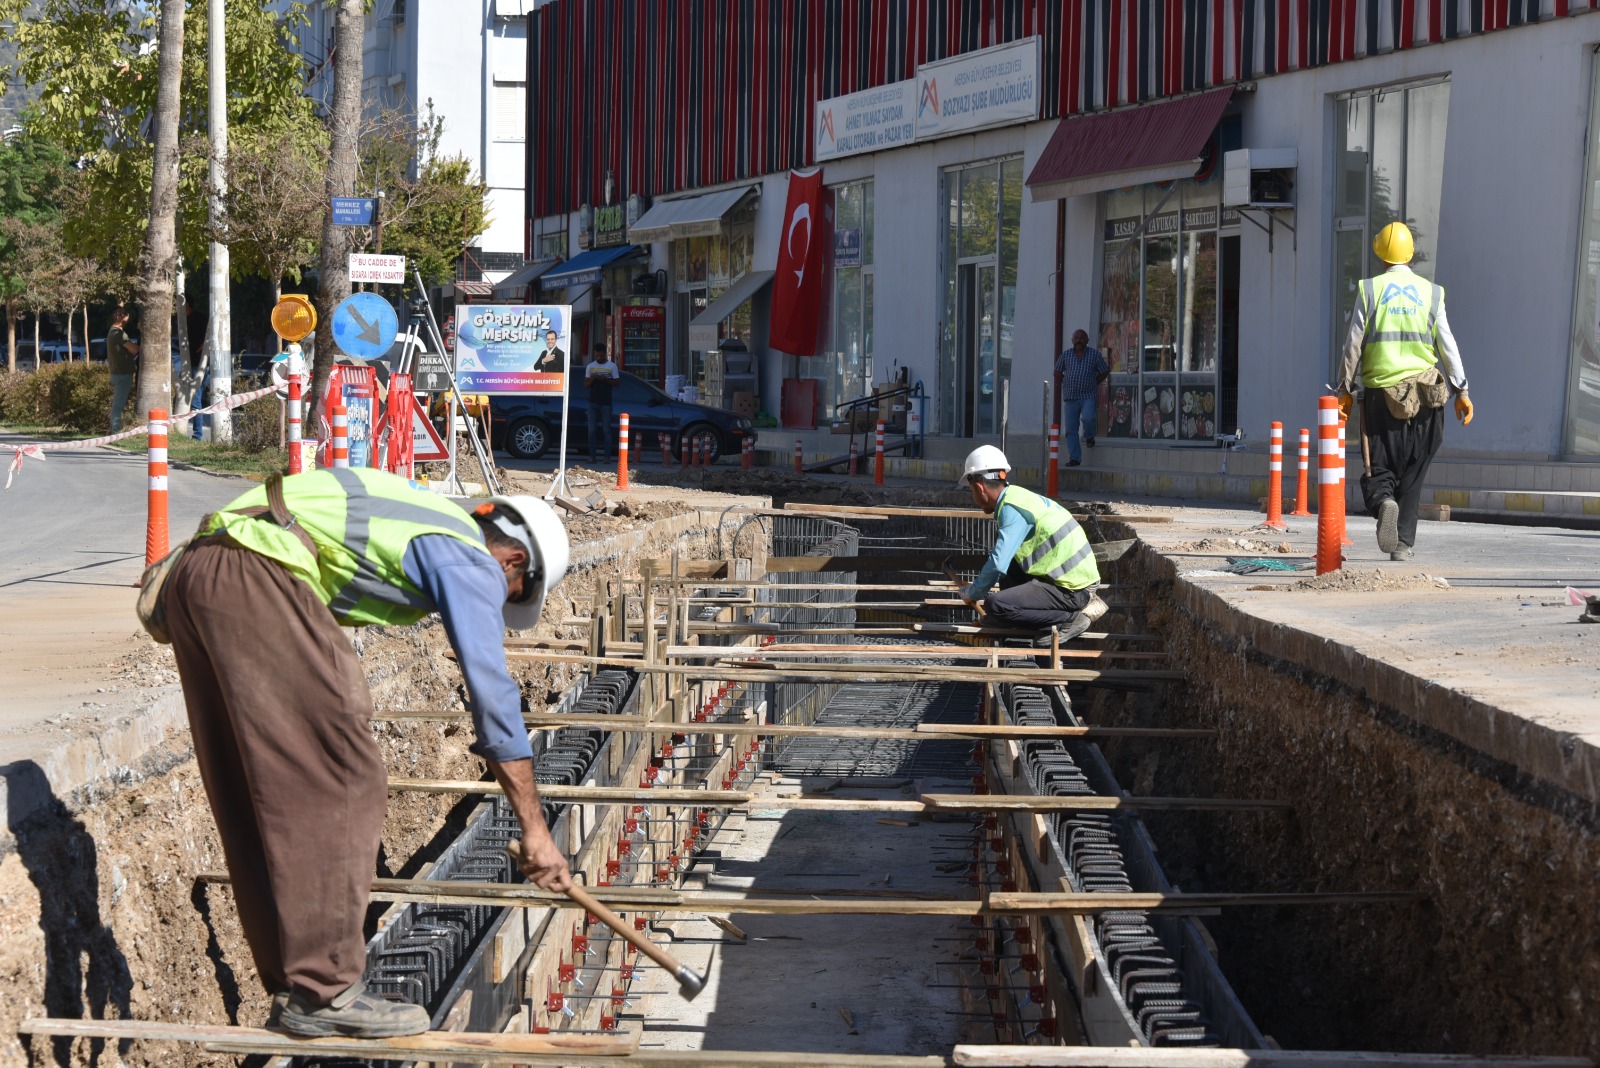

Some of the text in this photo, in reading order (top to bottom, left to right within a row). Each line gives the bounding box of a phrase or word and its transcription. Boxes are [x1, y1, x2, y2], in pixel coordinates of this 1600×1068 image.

[943, 74, 1033, 117] BOZYAZI ŞUBE MÜDÜRLÜĞÜ
[846, 105, 904, 131] AHMET YILMAZ SAYDAM
[836, 136, 853, 154] KAPALI
[853, 131, 877, 150] OTOPARK
[877, 134, 884, 144] ve
[884, 126, 902, 144] PAZAR
[1114, 221, 1136, 237] KASAP
[358, 258, 397, 267] BU CADDE DE
[1388, 306, 1417, 315] MESKİ
[473, 309, 551, 331] GÖREVİMİZ
[481, 327, 538, 343] MERSİN!
[503, 377, 534, 386] BÜYÜKŞEHİR
